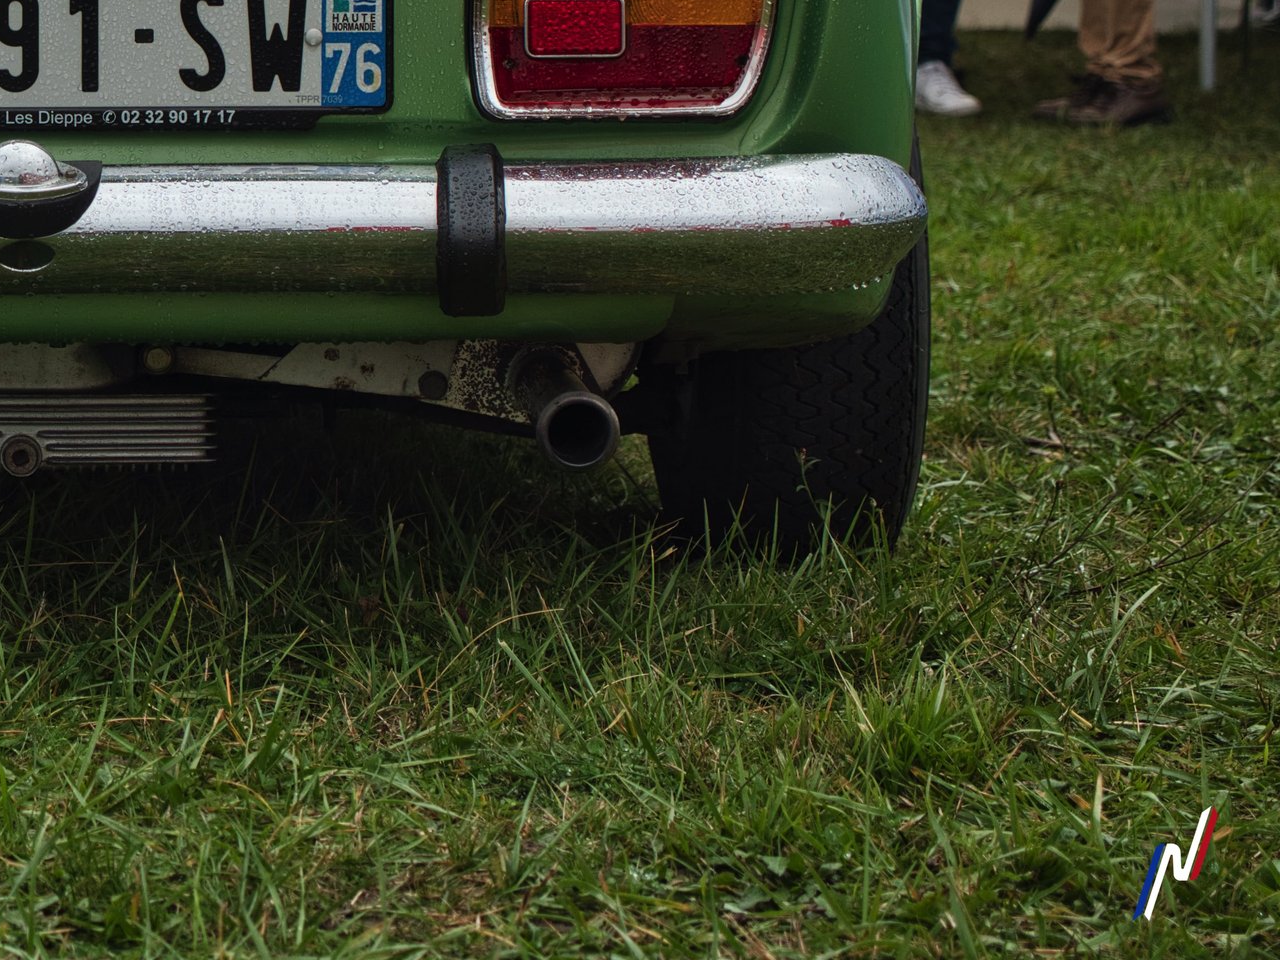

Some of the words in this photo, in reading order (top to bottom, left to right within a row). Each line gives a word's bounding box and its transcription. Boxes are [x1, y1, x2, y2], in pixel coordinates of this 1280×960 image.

[332, 13, 376, 23] HAUTE
[332, 22, 376, 32] NORMANDIE
[325, 42, 382, 94] 76
[5, 111, 33, 125] Les
[38, 110, 93, 127] Dieppe
[120, 110, 140, 124] 02
[145, 110, 164, 124] 32
[169, 110, 188, 124] 90
[193, 110, 212, 124] 17
[217, 110, 236, 124] 17
